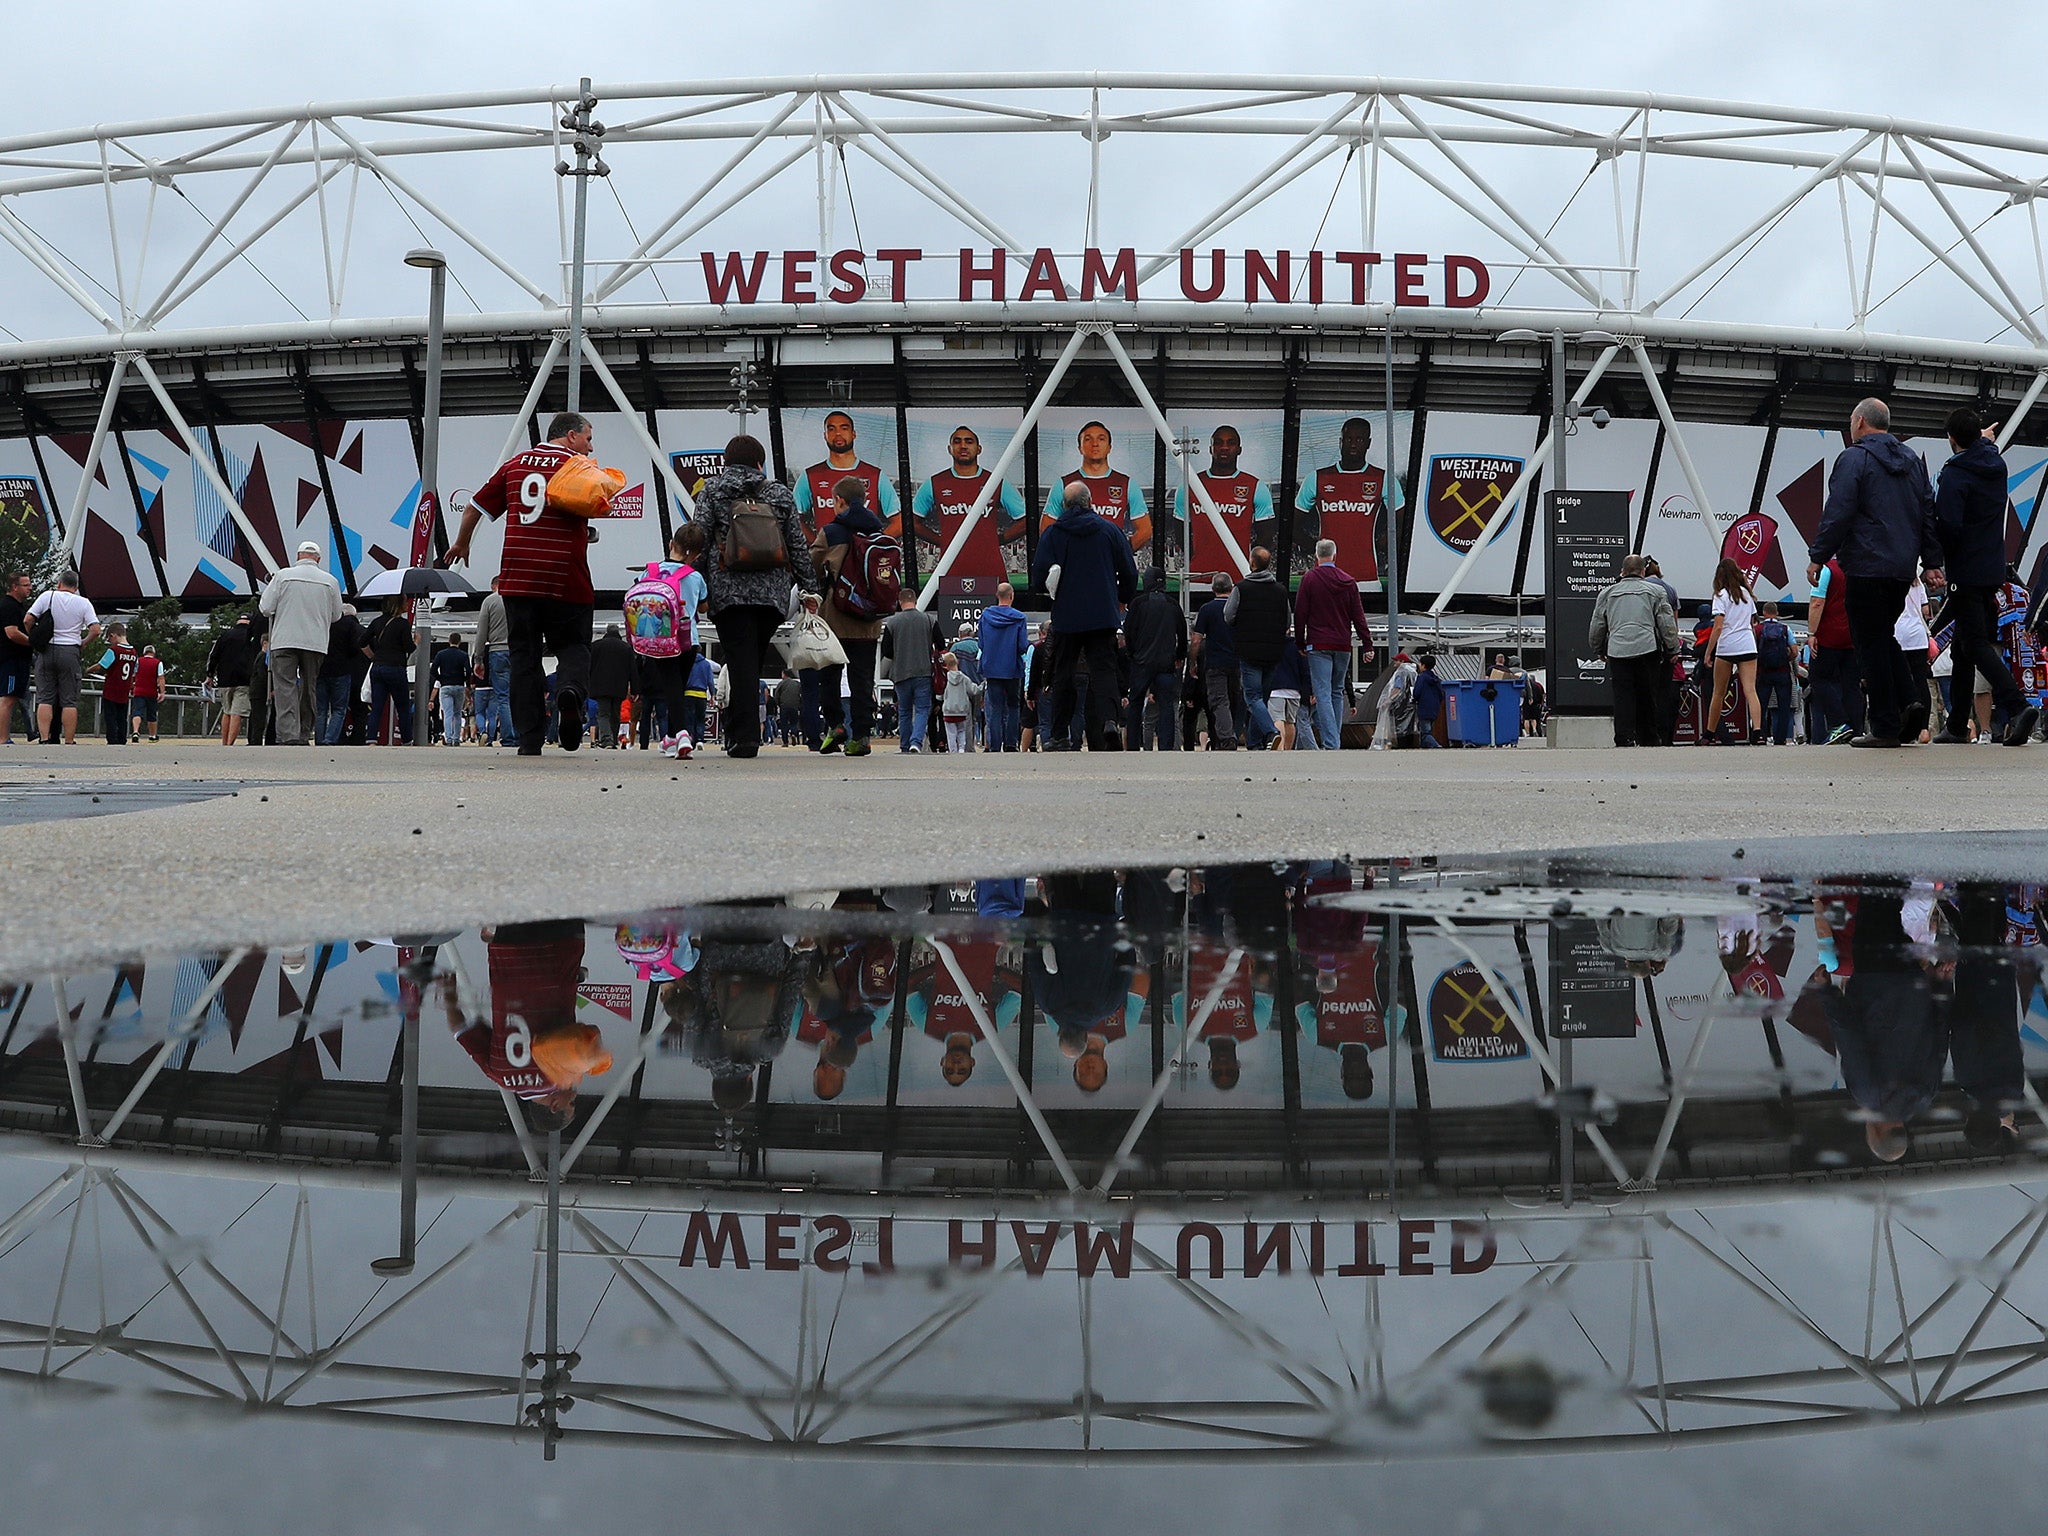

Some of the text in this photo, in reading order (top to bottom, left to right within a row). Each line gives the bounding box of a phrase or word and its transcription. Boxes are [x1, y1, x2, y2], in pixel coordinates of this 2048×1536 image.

[700, 248, 1491, 308] WEST HAM UNITED
[520, 455, 560, 467] FITZY
[680, 455, 717, 468] WEST
[1440, 459, 1514, 473] WEST HAM
[696, 466, 724, 475] UNIT
[1454, 470, 1497, 480] UNITED
[8, 480, 33, 490] HAM
[0, 490, 25, 499] NITED
[519, 472, 547, 525] 9
[618, 496, 642, 504] QUEEN
[1321, 500, 1375, 516] betway
[1556, 497, 1581, 507] Bridge
[940, 503, 993, 518] bety
[1091, 504, 1122, 519] way
[1192, 502, 1246, 517] bway
[1659, 508, 1738, 521] Newham ndon
[1558, 508, 1568, 524] 1
[1450, 536, 1476, 546] LONDO
[1566, 576, 1587, 584] Queen
[1571, 584, 1597, 592] Olympic
[953, 609, 981, 620] A B C
[122, 662, 130, 680] 9
